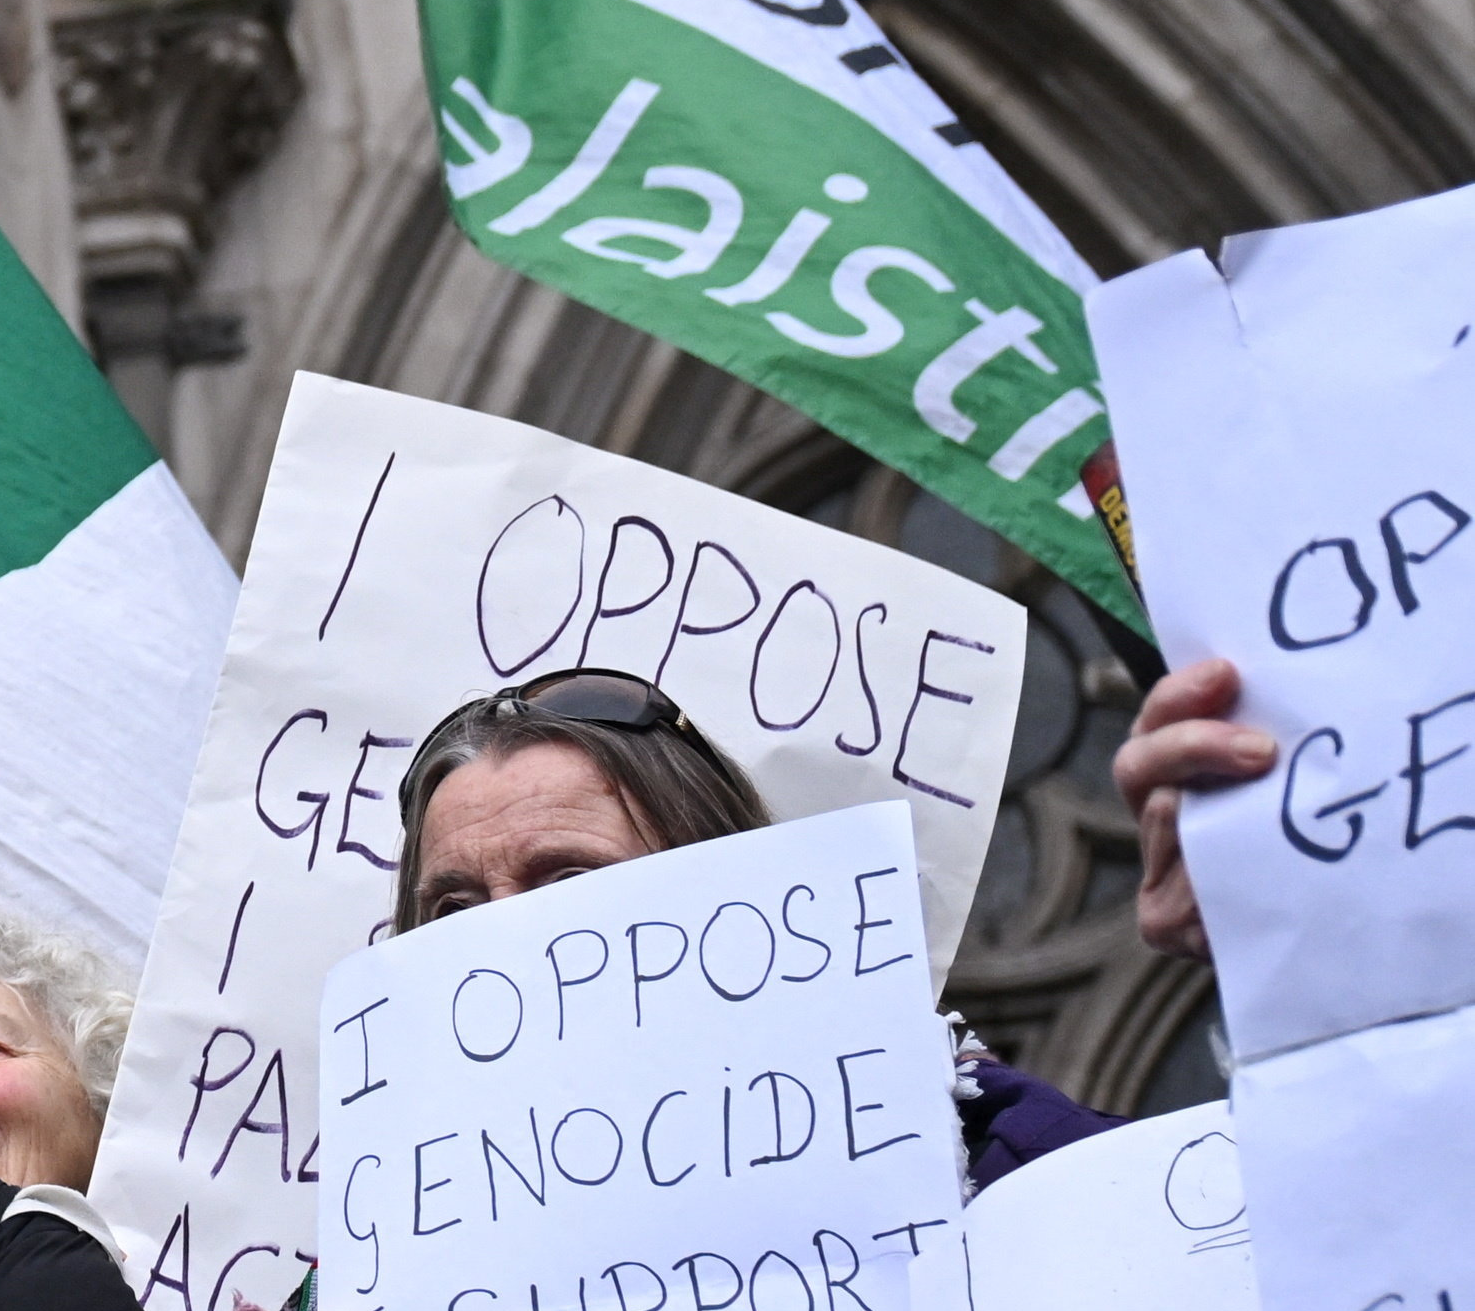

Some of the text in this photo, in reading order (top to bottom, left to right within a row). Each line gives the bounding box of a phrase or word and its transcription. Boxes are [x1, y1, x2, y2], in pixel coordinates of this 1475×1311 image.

[319, 451, 395, 641] I
[476, 493, 995, 809] OPPOSE
[335, 997, 388, 1107] I
[452, 867, 913, 1063] OPPOSE
